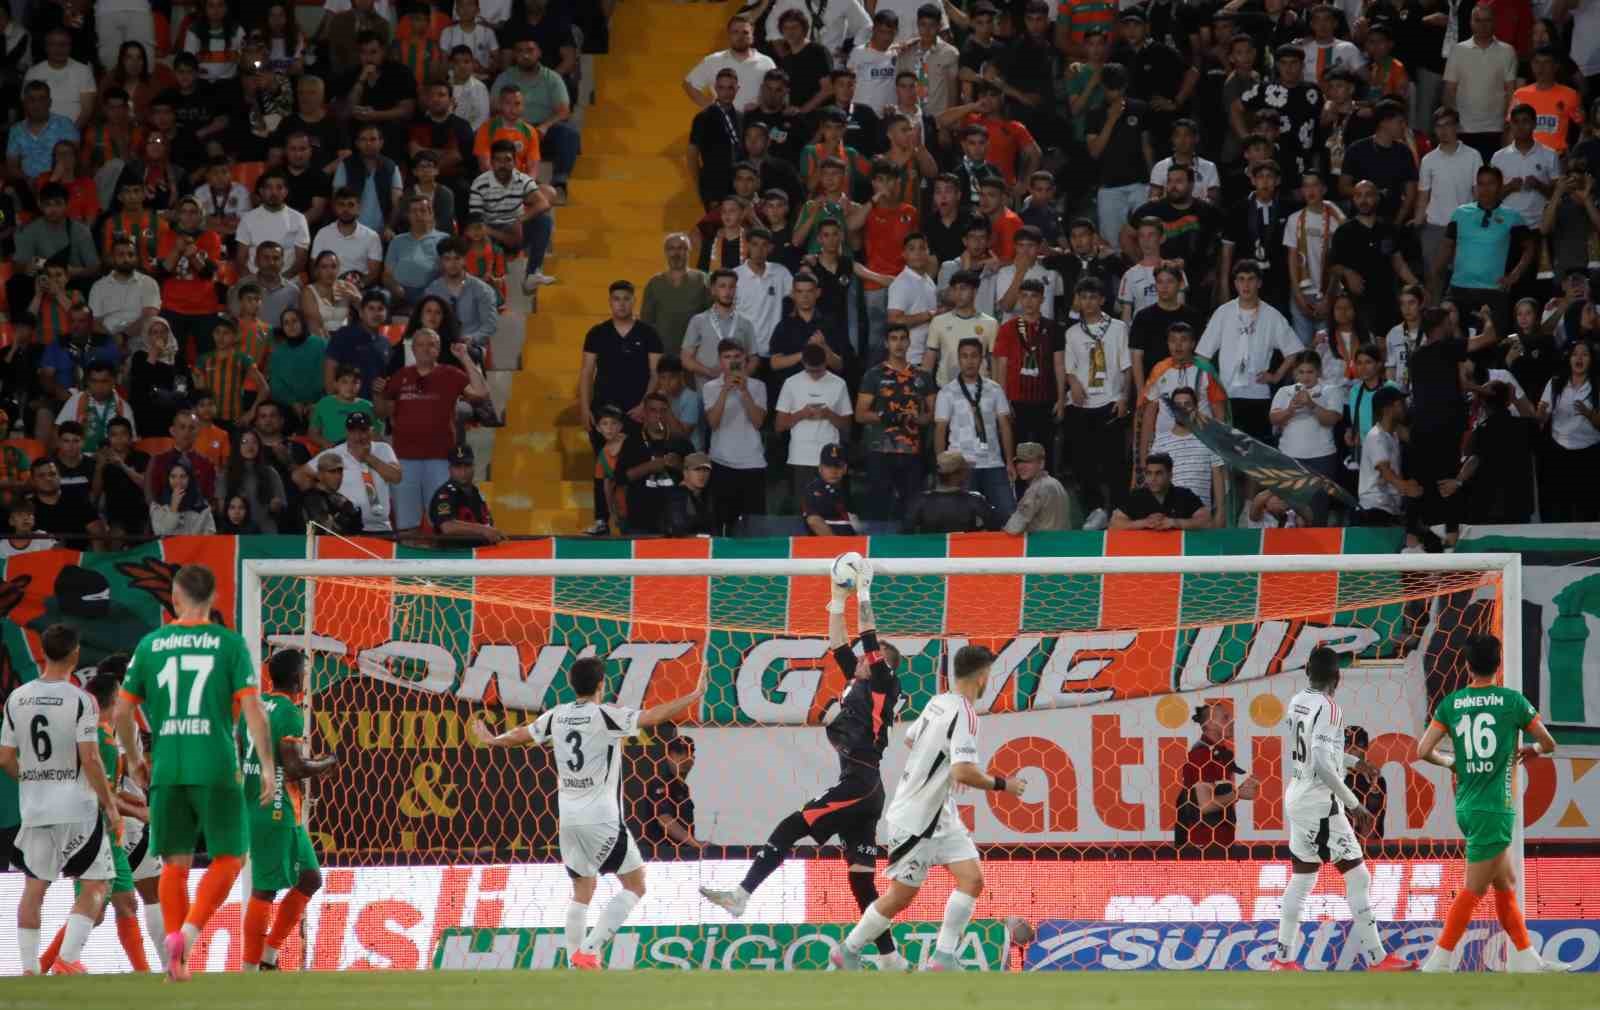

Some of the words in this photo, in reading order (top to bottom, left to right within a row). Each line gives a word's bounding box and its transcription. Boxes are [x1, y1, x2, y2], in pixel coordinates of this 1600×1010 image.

[1180, 620, 1380, 692] UP
[156, 655, 214, 716] 17
[30, 715, 52, 762] 6
[565, 731, 585, 772] 3
[1456, 713, 1496, 759] 16
[400, 761, 460, 819] &
